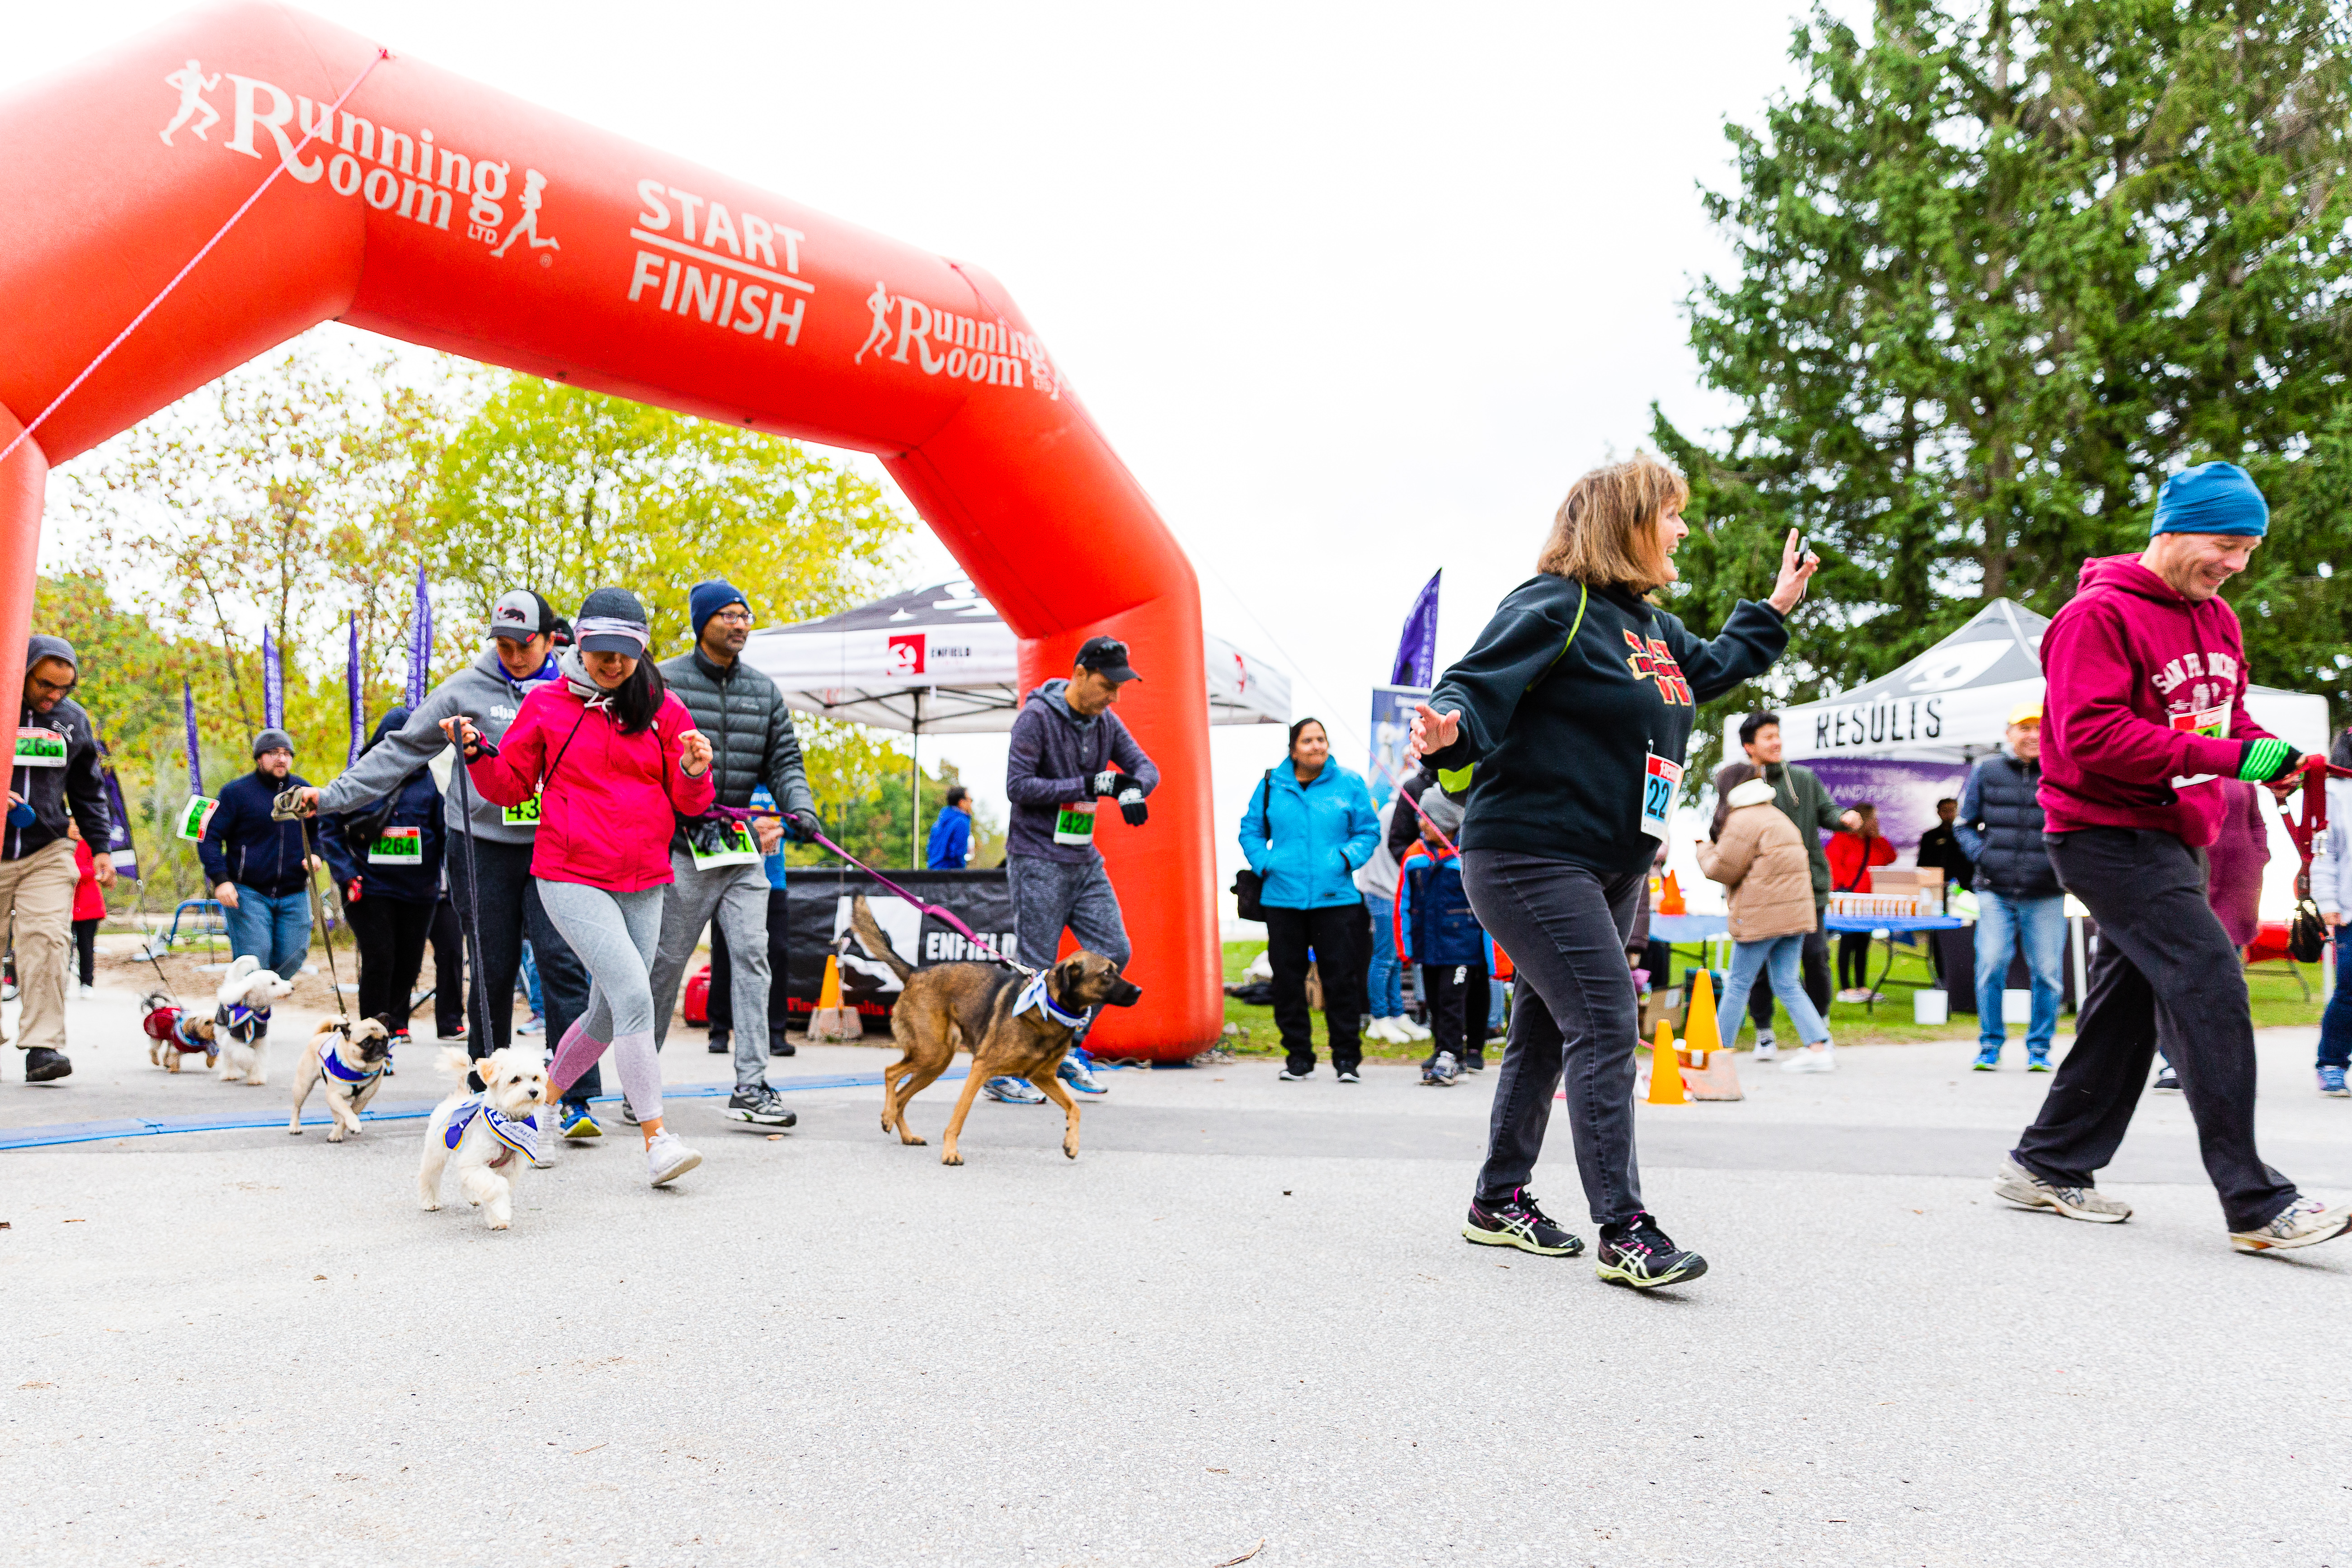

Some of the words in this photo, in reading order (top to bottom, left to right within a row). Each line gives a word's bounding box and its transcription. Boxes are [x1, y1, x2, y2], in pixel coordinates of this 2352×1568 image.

[224, 72, 510, 227] Running
[637, 179, 805, 274] START
[628, 250, 806, 346] FINISH
[889, 295, 1049, 380] Running
[2151, 658, 2187, 695] SAN
[508, 797, 540, 819] 43
[1647, 778, 1669, 819] 22
[926, 932, 1018, 961] ENFIELD
